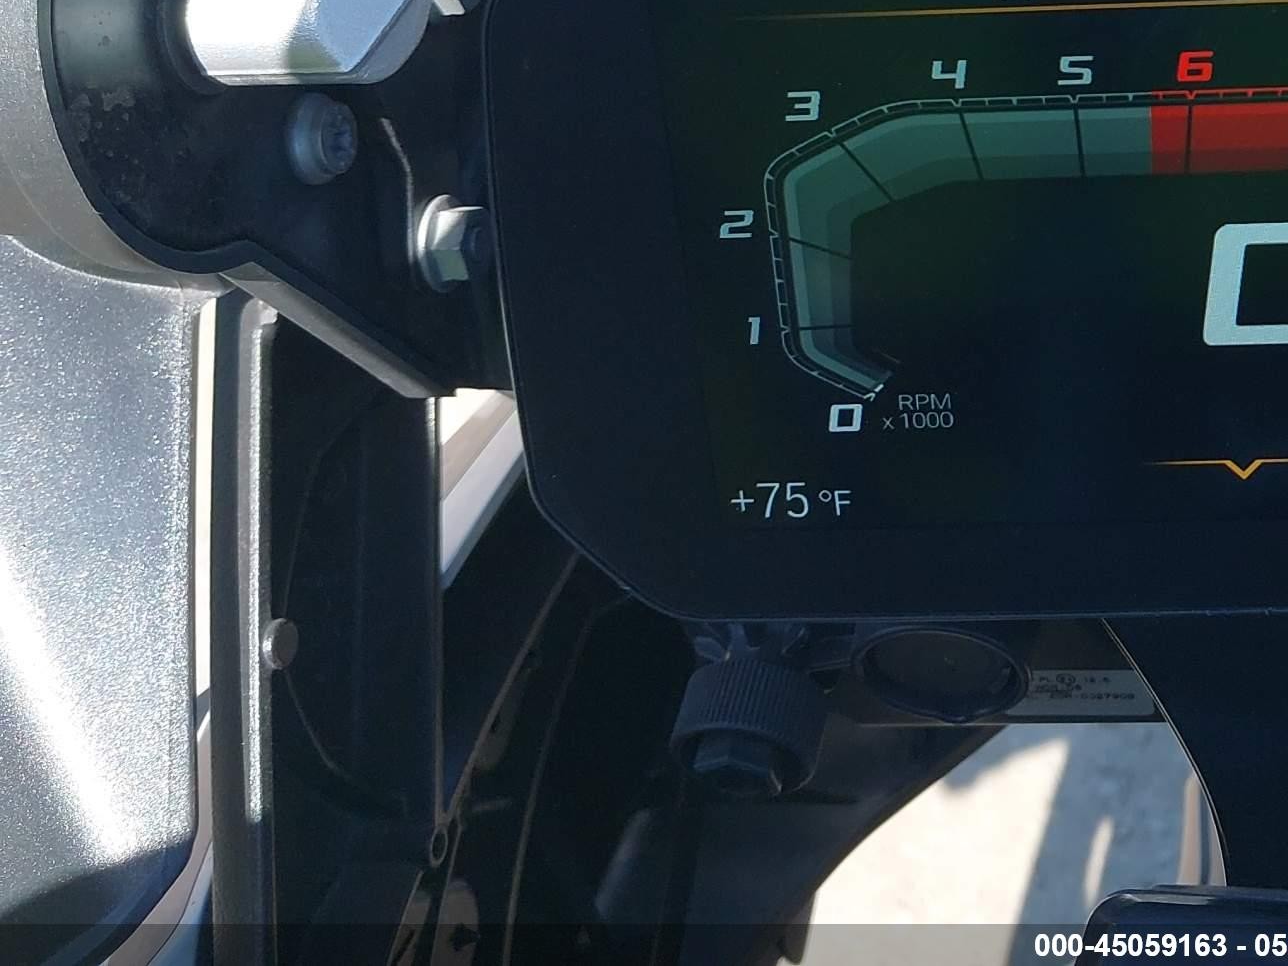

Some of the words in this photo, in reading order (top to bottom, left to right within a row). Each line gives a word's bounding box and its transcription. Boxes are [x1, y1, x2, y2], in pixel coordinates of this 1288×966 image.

[932, 60, 966, 88] 4
[1058, 56, 1093, 85] 5
[1178, 52, 1212, 81] 6
[786, 91, 820, 121] 3
[720, 210, 754, 238] 2
[748, 317, 760, 344] 1
[899, 394, 951, 410] RPM
[829, 404, 862, 432] 0
[900, 411, 953, 429] 1000
[731, 483, 808, 518] +75
